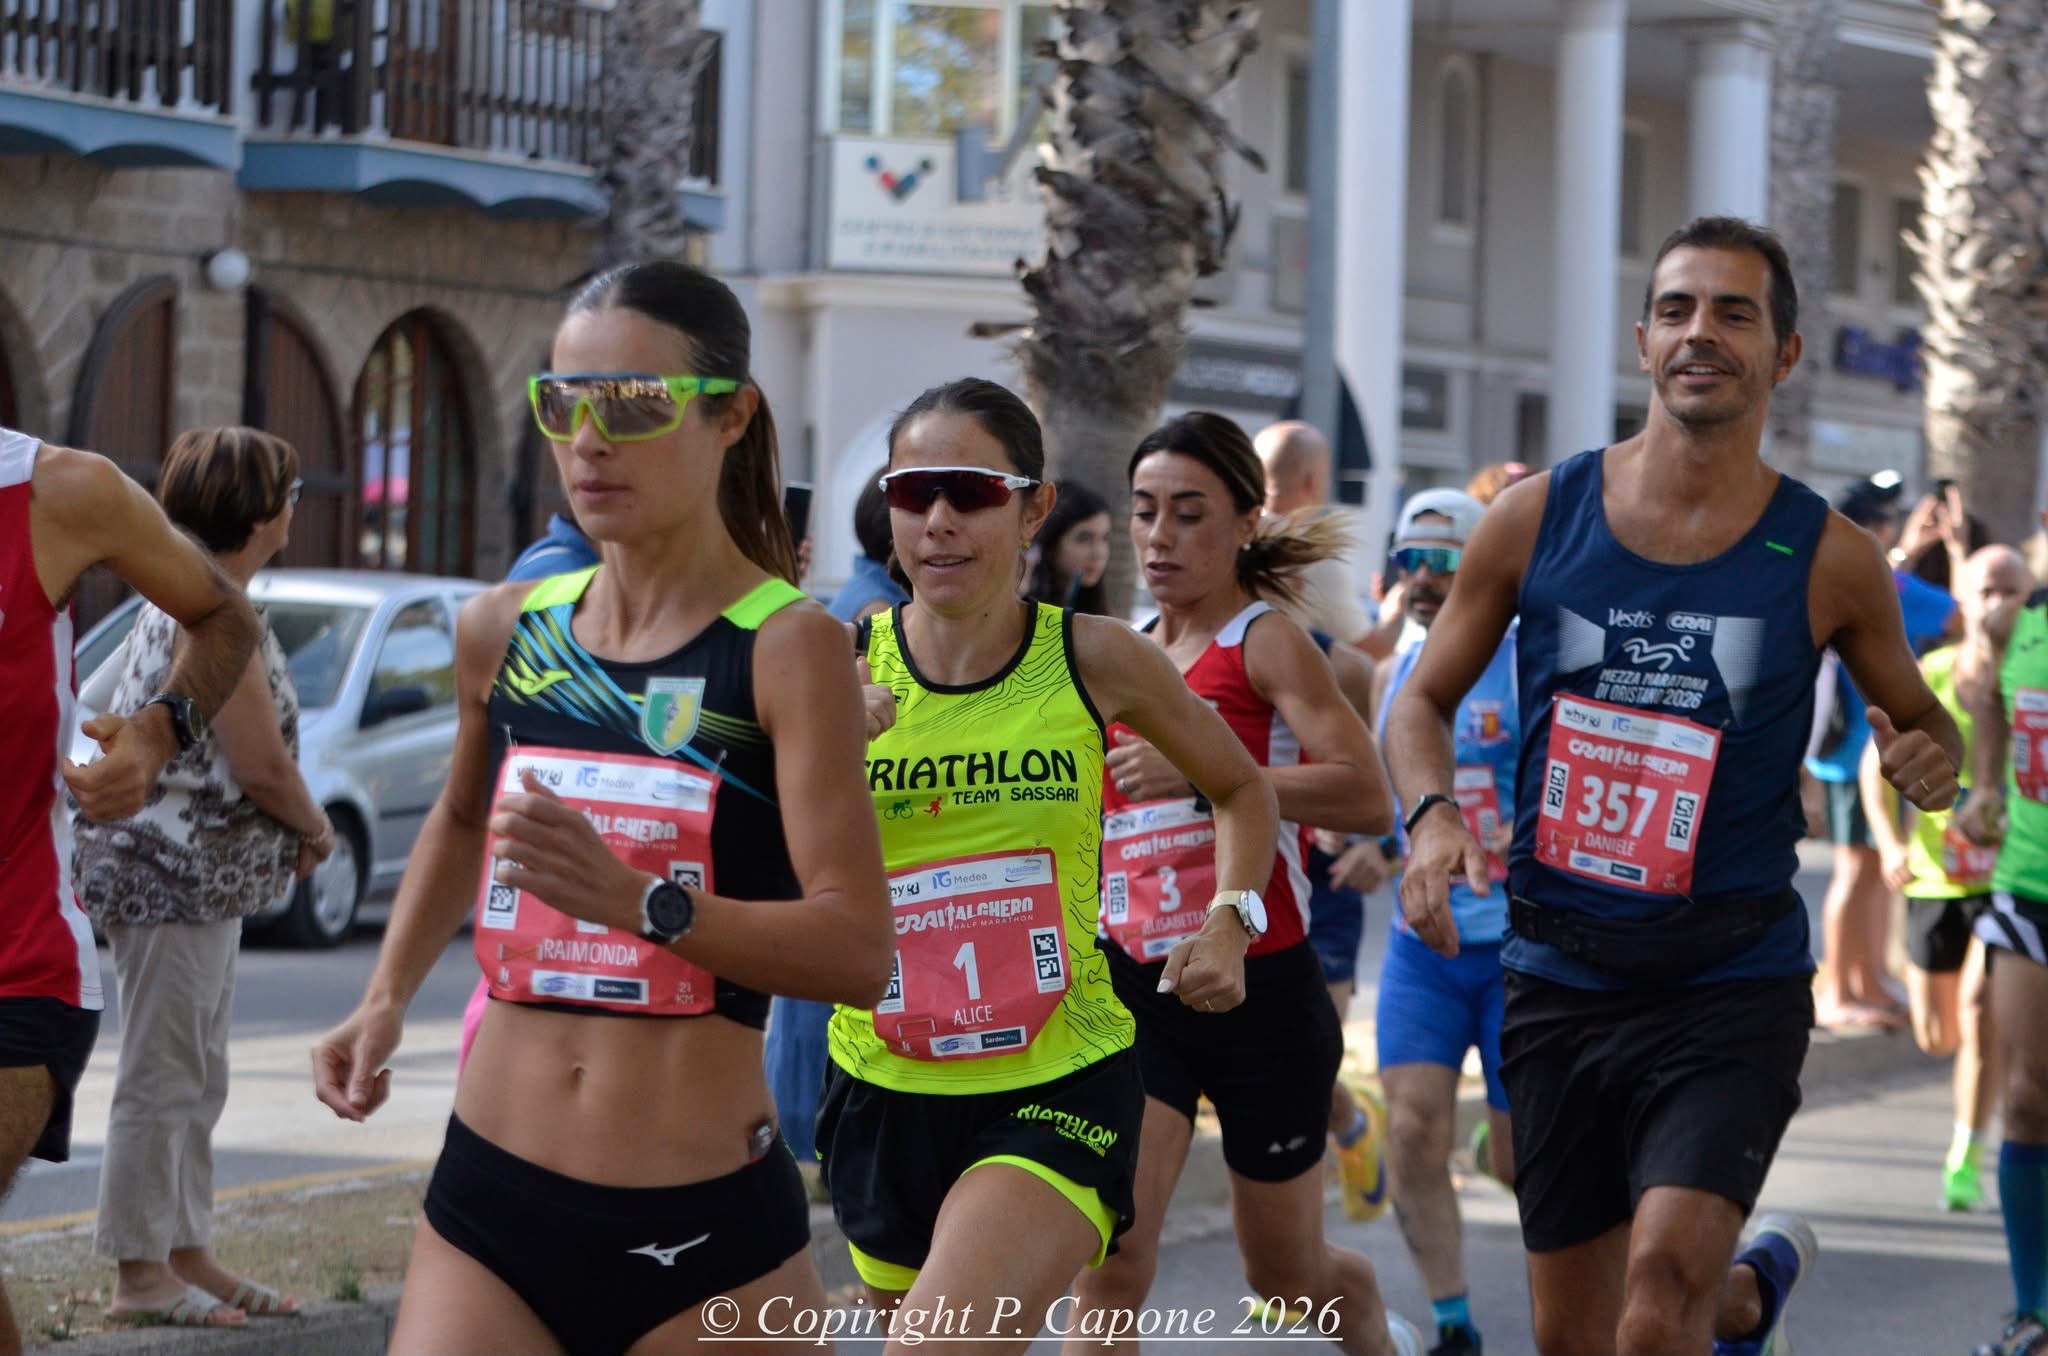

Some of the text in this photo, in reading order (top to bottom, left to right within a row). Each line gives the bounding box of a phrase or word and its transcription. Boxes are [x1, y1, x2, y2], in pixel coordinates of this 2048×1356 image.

[1671, 615, 1711, 631] CRAI
[1600, 669, 1709, 692] MEZZA MARATONA
[1595, 683, 1610, 699] DI
[1662, 689, 1703, 710] 2026
[953, 786, 1079, 805] TEAM SASSARI
[1576, 775, 1659, 838] 357
[1585, 832, 1637, 857] DANIELE
[954, 872, 988, 884] Medea
[1158, 866, 1181, 912] 3
[888, 883, 905, 898] hy
[954, 914, 1033, 930] HALF MARATHON
[543, 938, 638, 967] RAIMONDA
[953, 941, 981, 1000] 1
[679, 982, 691, 993] 21
[676, 994, 695, 1004] KM
[953, 1005, 993, 1026] ALICE
[1010, 1104, 1118, 1149] RIATHLON
